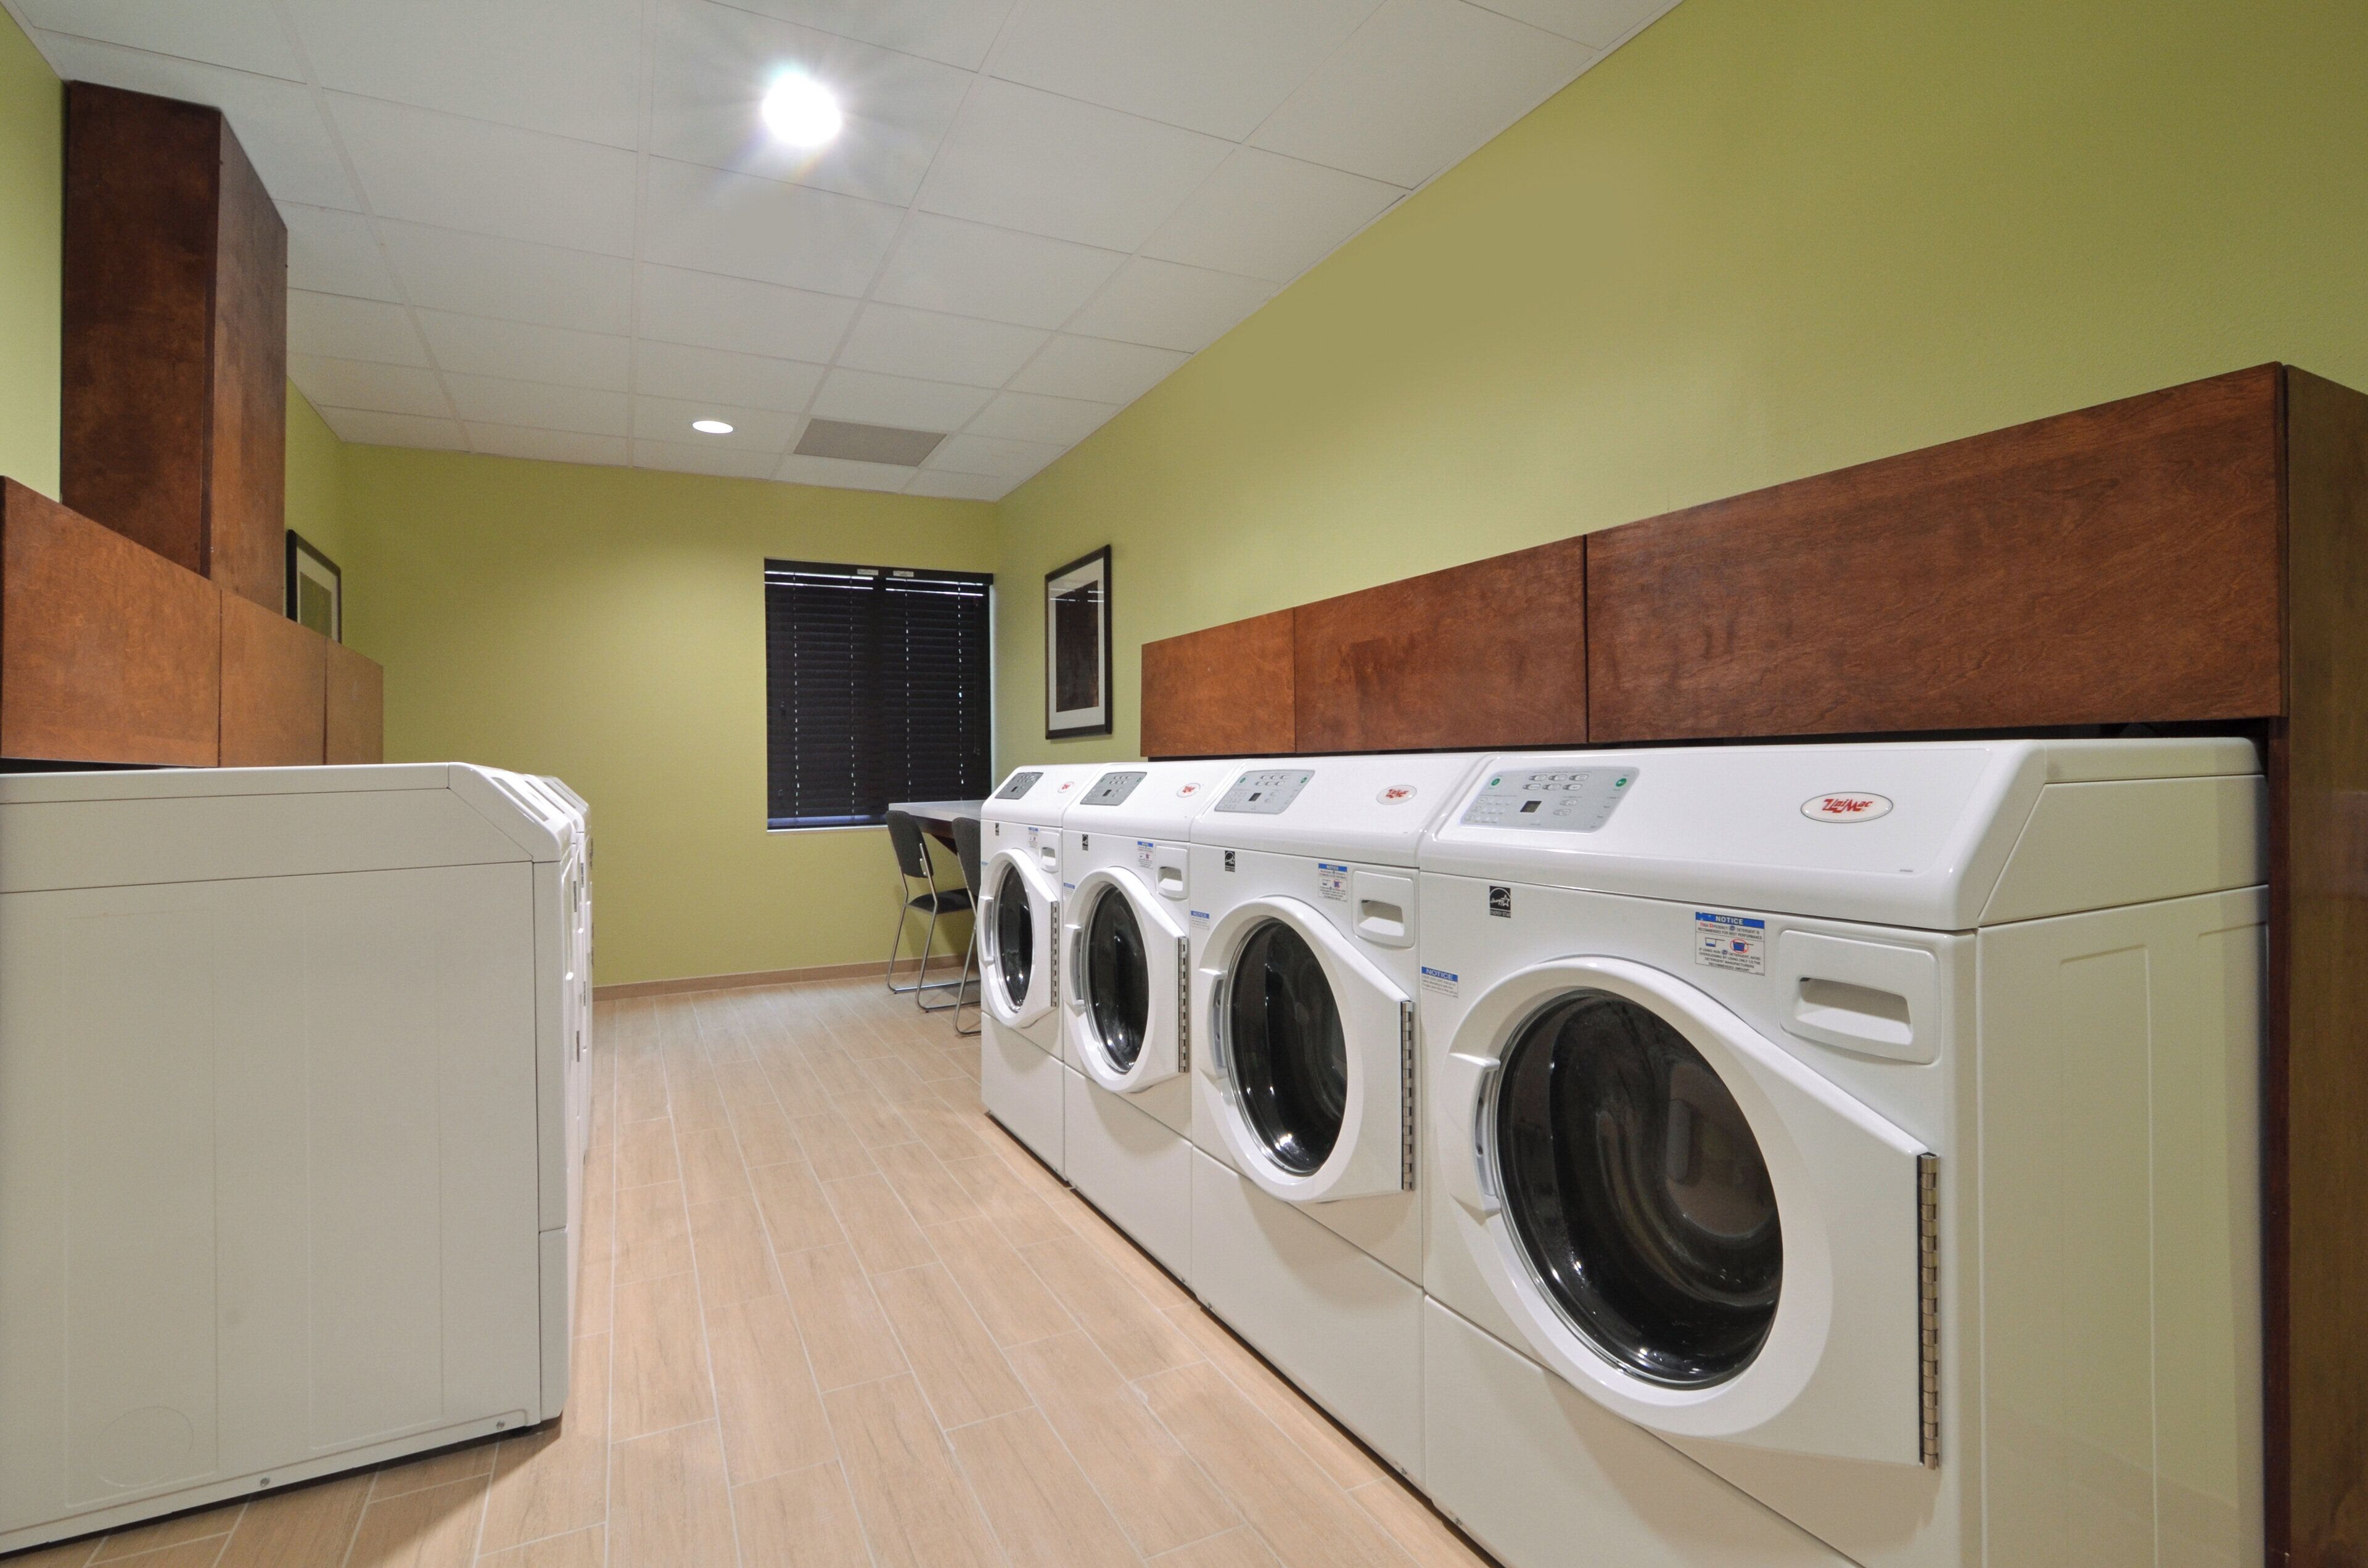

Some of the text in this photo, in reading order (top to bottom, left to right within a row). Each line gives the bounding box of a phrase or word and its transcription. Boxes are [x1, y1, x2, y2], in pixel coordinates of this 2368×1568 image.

[1822, 798, 1873, 813] UniMac
[1716, 916, 1744, 925] NOTICE
[1426, 969, 1453, 980] NOTICE
